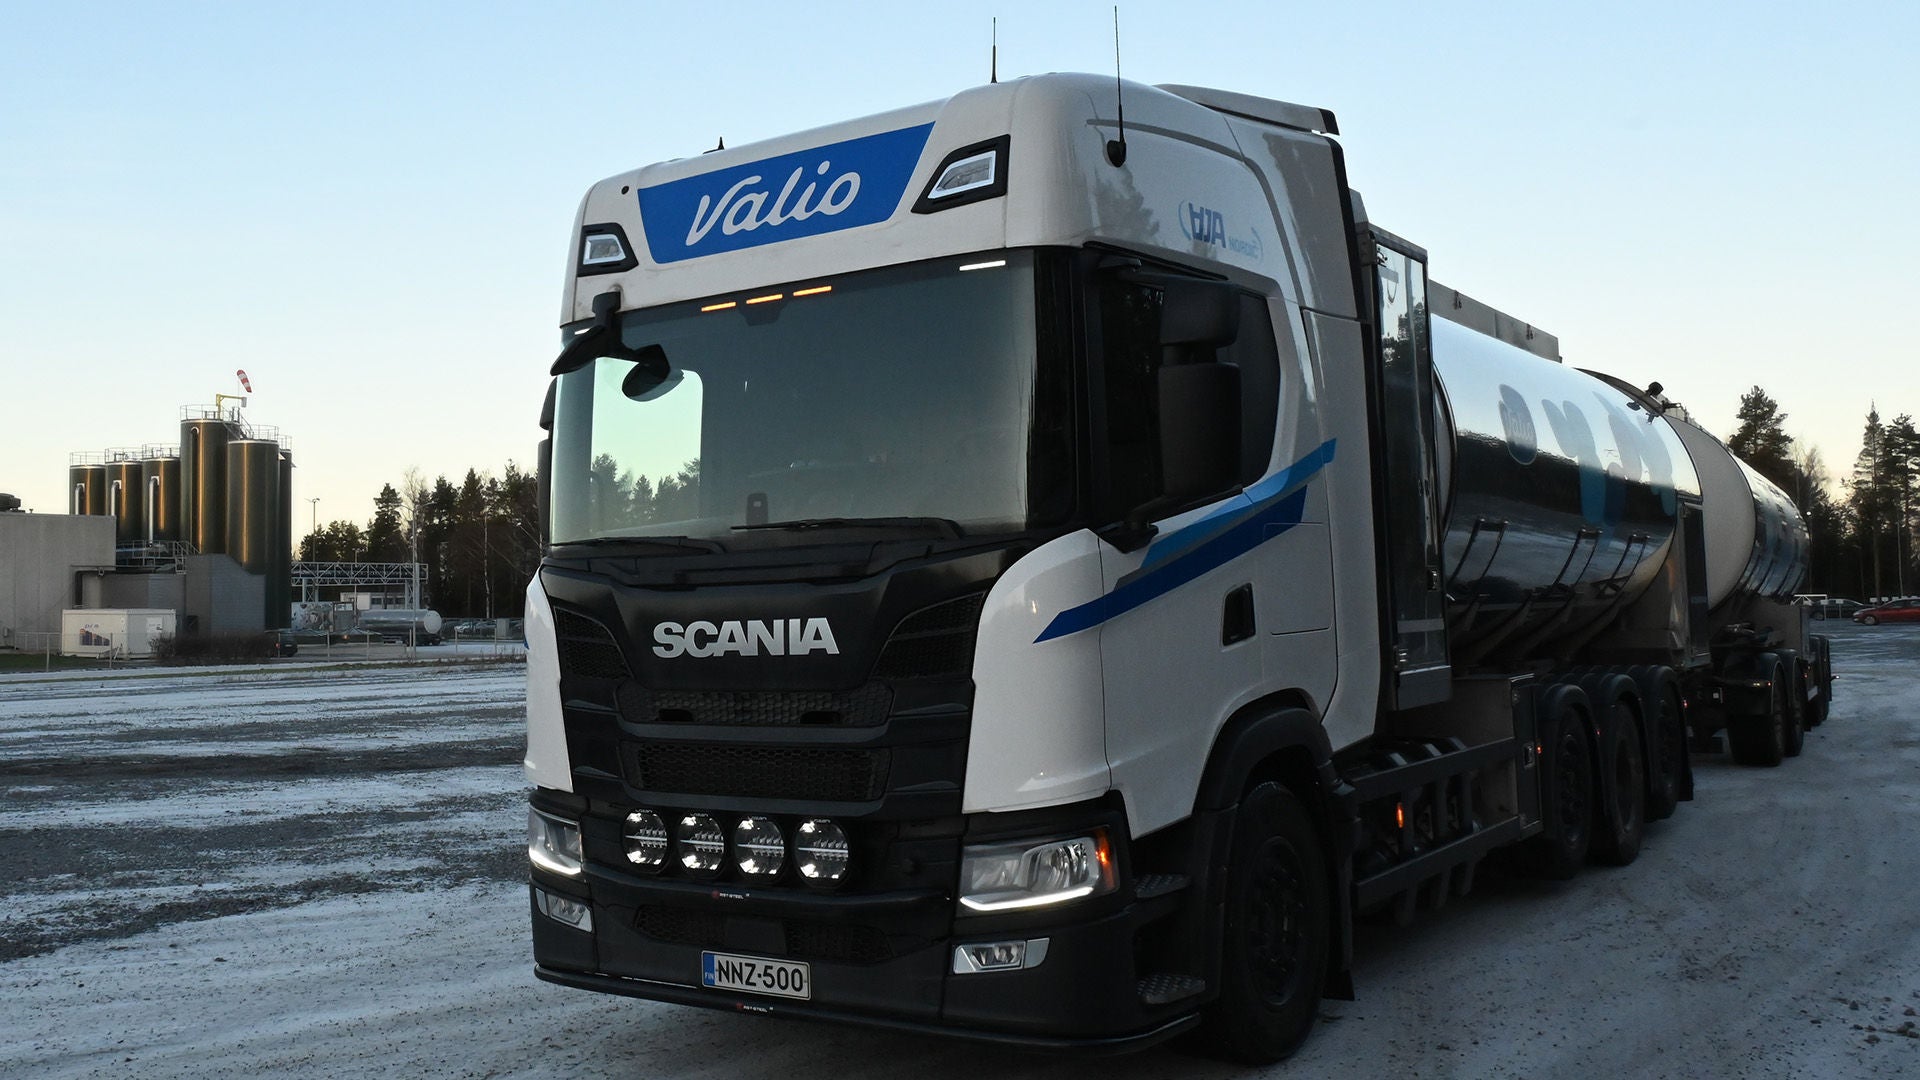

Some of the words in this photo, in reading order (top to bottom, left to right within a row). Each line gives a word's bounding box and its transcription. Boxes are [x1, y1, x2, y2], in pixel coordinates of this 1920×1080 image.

[685, 160, 861, 246] Valio
[652, 617, 840, 658] SCANIA
[717, 959, 803, 992] NNZ-500
